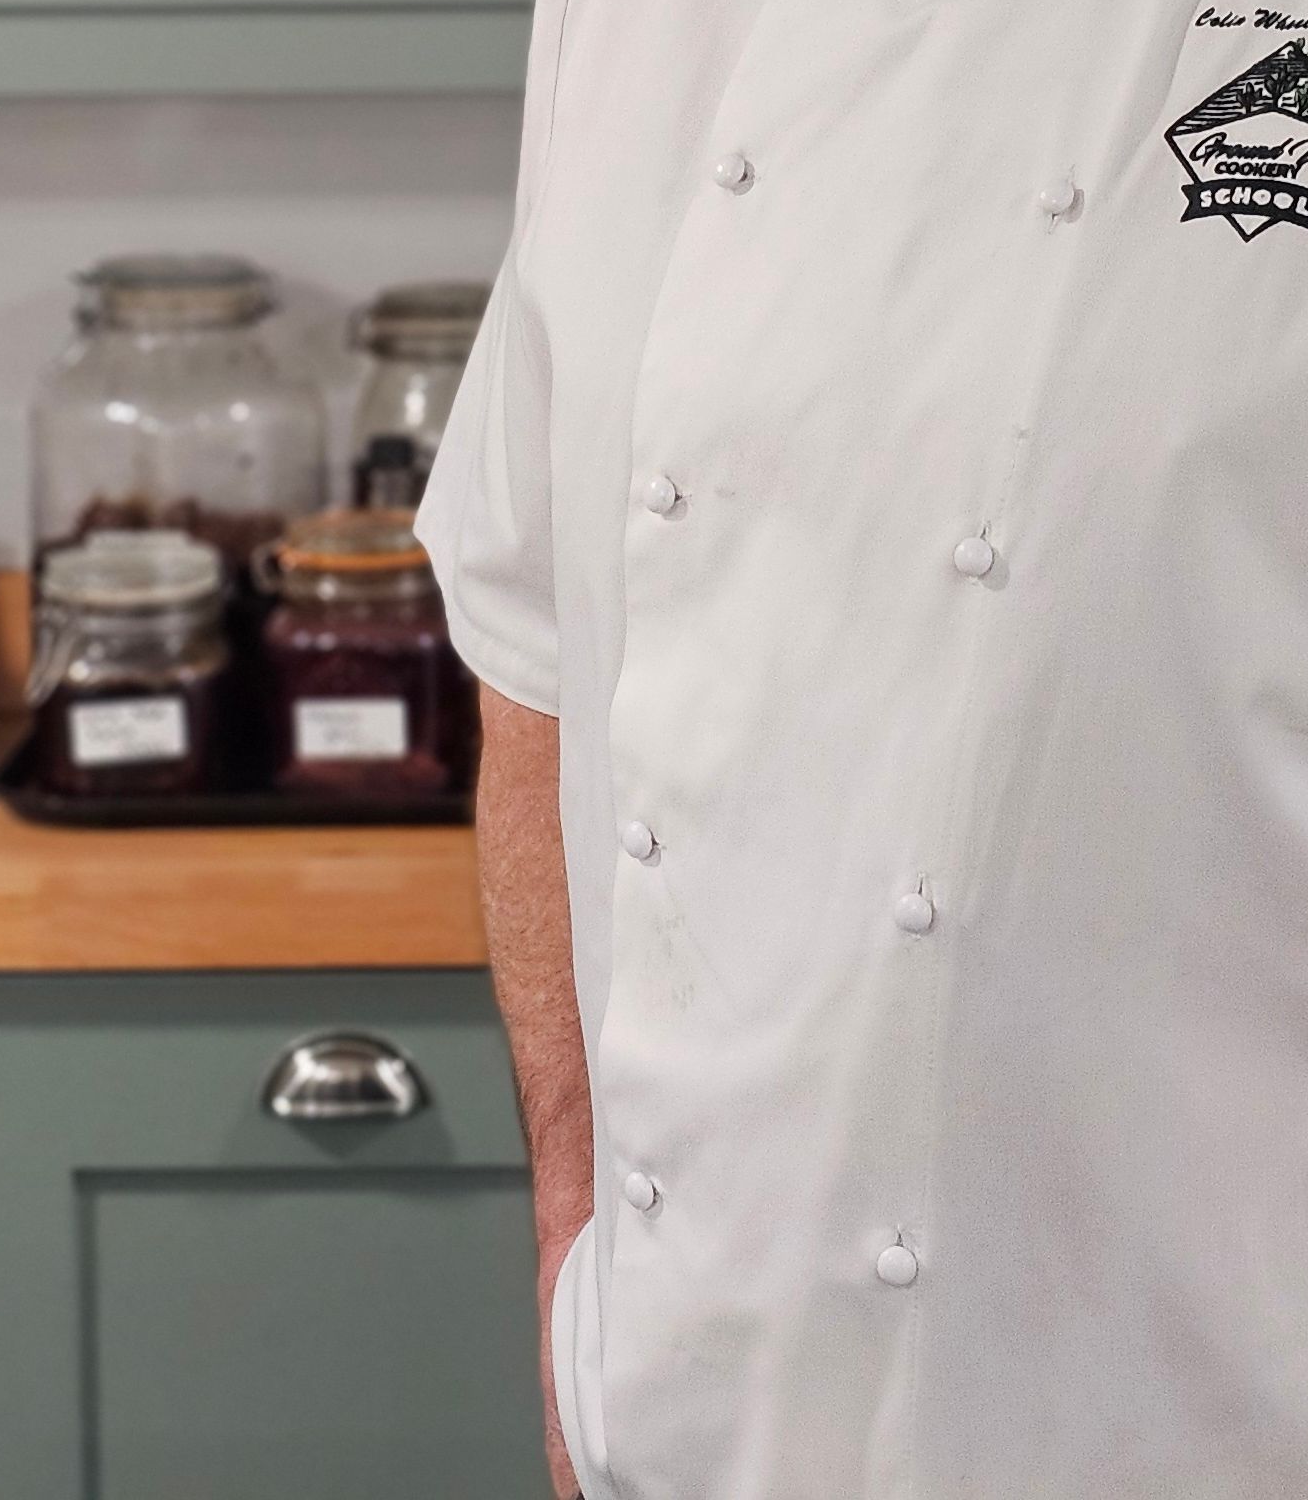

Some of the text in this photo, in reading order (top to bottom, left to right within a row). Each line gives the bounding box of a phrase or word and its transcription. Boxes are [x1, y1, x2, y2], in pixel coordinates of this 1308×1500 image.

[1195, 7, 1246, 28] Colin
[1189, 132, 1294, 167] Ground
[1214, 161, 1299, 179] COOKERY
